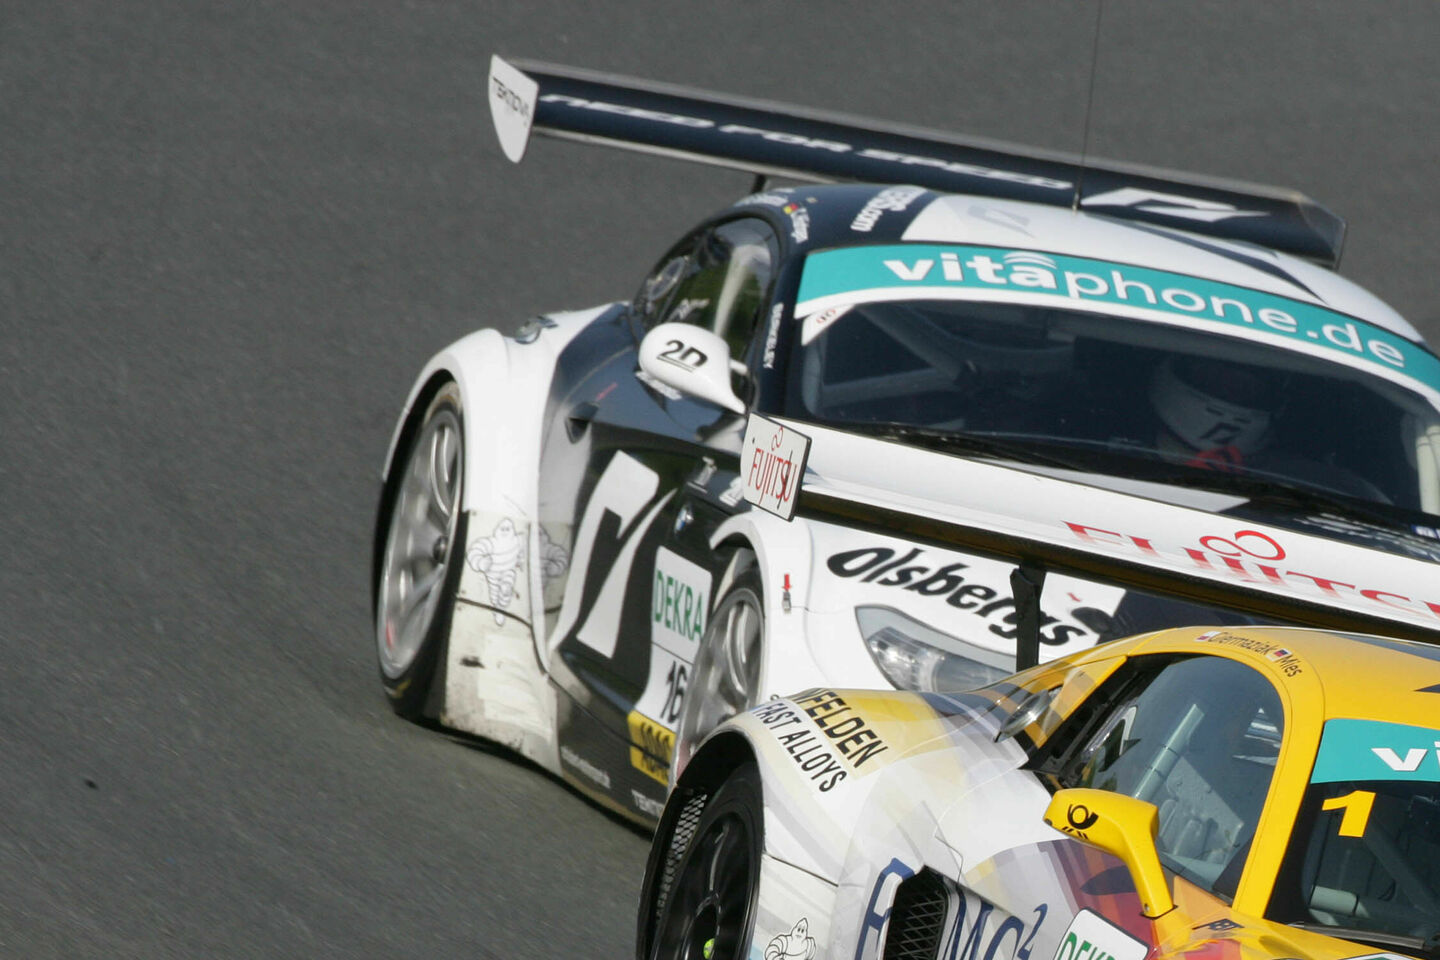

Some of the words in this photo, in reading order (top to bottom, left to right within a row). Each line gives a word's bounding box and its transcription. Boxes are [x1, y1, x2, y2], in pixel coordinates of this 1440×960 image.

[882, 249, 1405, 368] vitaphone.de
[747, 447, 798, 506] FUJITSU
[655, 570, 703, 642] DEKRA
[659, 660, 688, 725] 16
[777, 729, 848, 793] ALLOYS
[1321, 790, 1377, 838] 1
